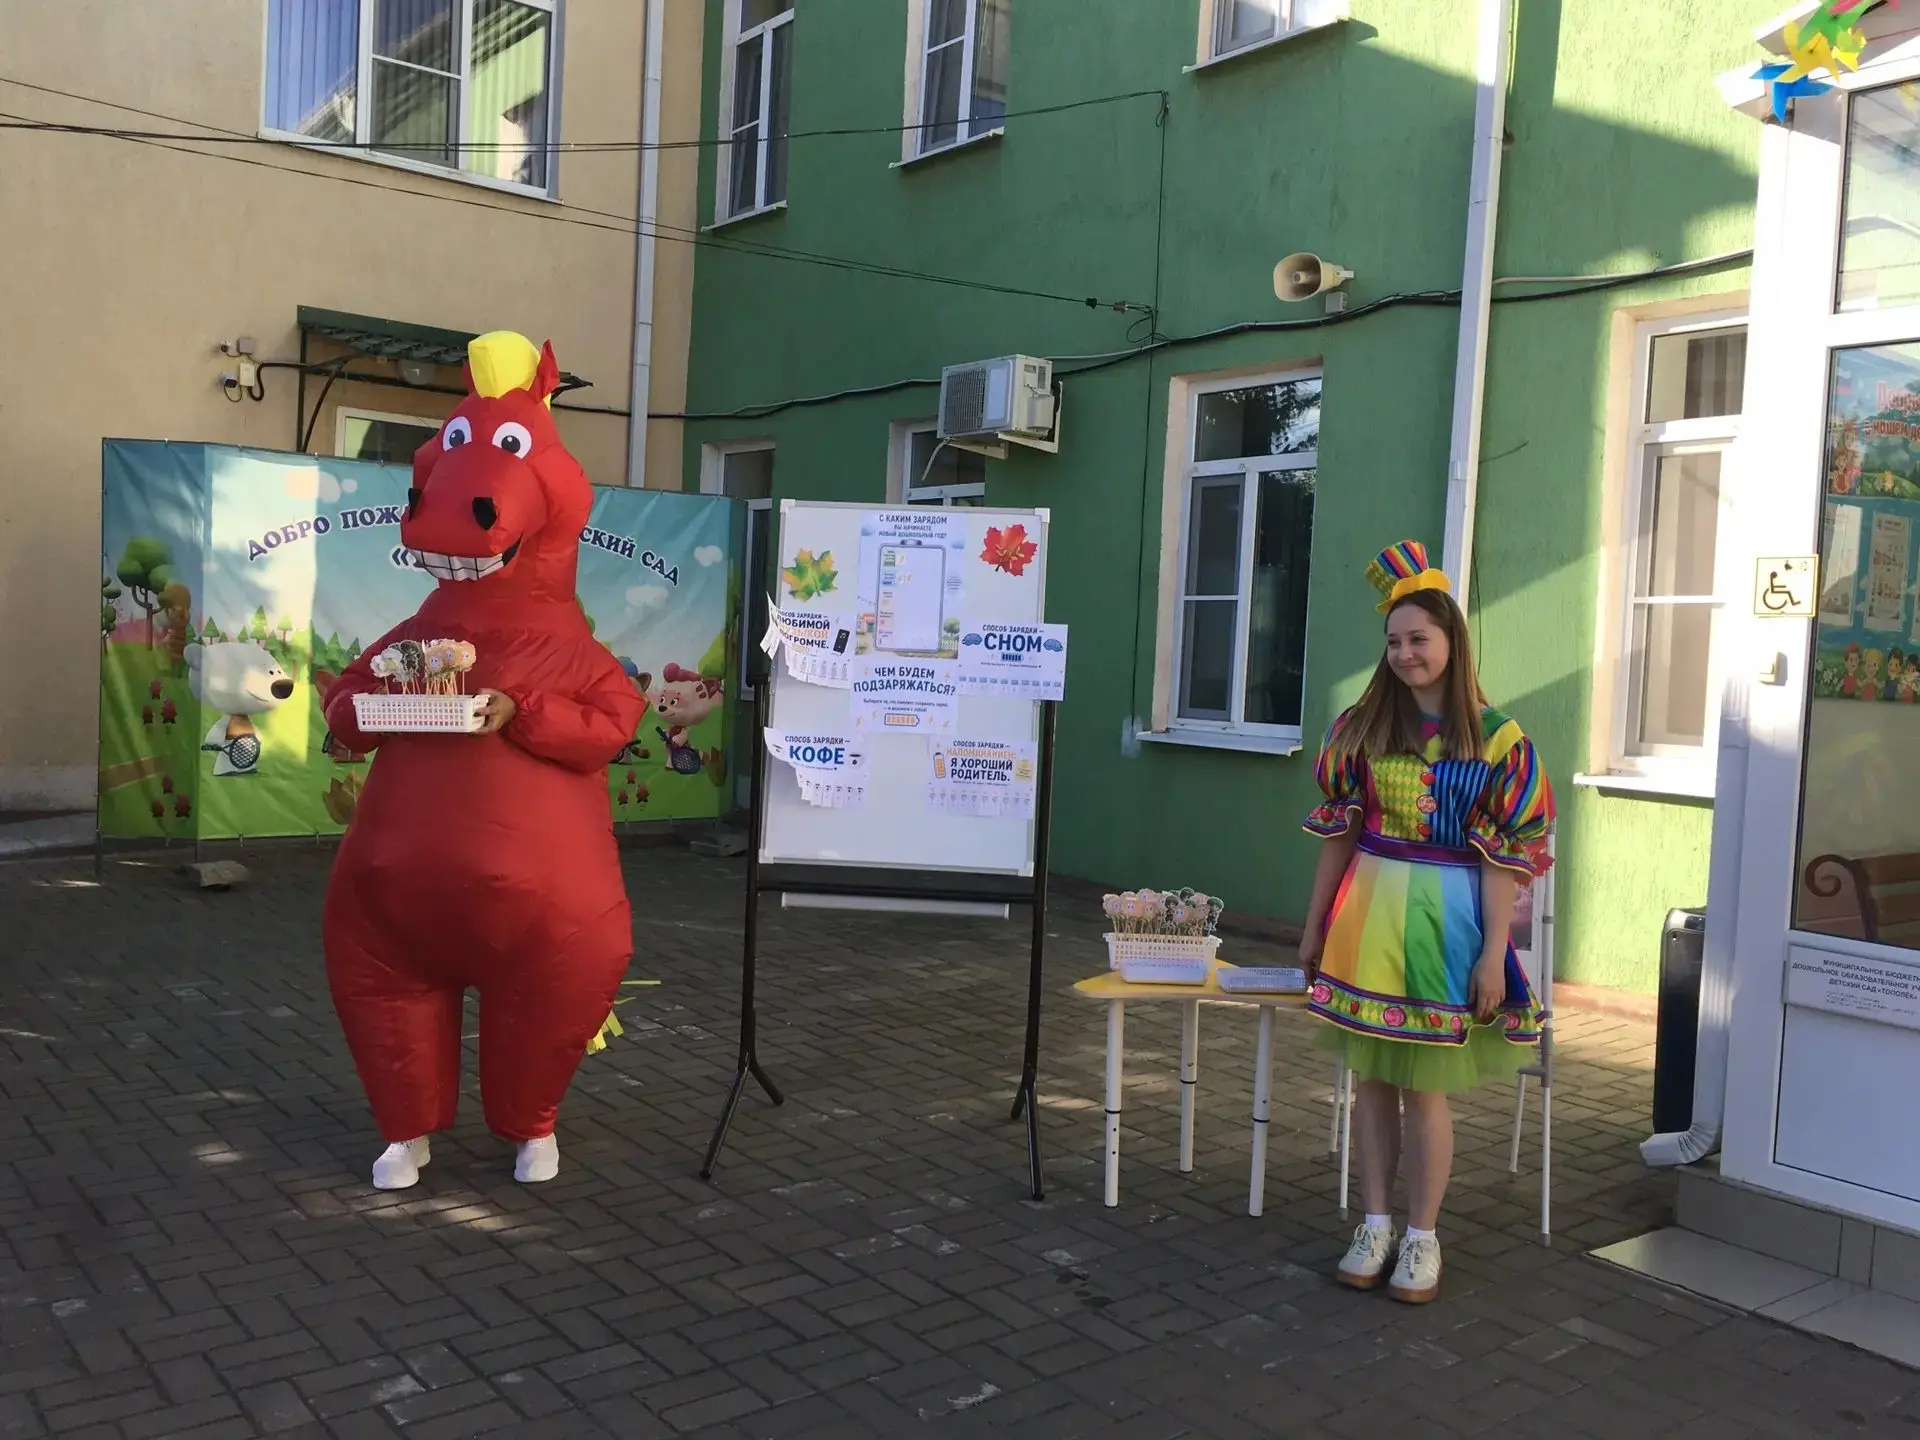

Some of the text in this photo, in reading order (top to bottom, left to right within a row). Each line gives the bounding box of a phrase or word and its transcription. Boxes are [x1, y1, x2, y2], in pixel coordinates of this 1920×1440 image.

[879, 513, 947, 525] С КАКИМ ЗАРЯДОМ
[247, 516, 330, 561] ДОБРО
[579, 526, 636, 559] СКИЙ
[641, 551, 679, 586] САД
[796, 612, 822, 620] ЗАРЯДКИ
[982, 624, 1007, 633] СПОСОБ
[1009, 626, 1038, 634] ЗАРЯДКИ
[984, 632, 1042, 653] СНОМ
[875, 666, 935, 679] ЧЕМ БУДЕМ
[853, 679, 956, 696] ПОДЗАРЯЖАТЬСЯ?
[785, 735, 811, 744] СПОСОБ
[812, 736, 844, 745] ЗАРЯДКИ
[953, 740, 976, 748] СПОСОБ
[977, 741, 1004, 749] ЗАРЯДКИ
[789, 745, 845, 765] КОФЕ
[950, 758, 1013, 771] Я ХОРОШИЙ
[951, 768, 1011, 782] РОДИТЕЛЬ.
[1823, 959, 1884, 976] МУНИЦИПАЛЬНОЕ
[1792, 962, 1839, 977] ДОШКОЛЬНОЕ
[1841, 972, 1910, 990] ОБРАЗОВАТЕЛЬНОЕ
[1829, 978, 1861, 990] ДЕТСКИЙ
[1861, 984, 1877, 993] САД
